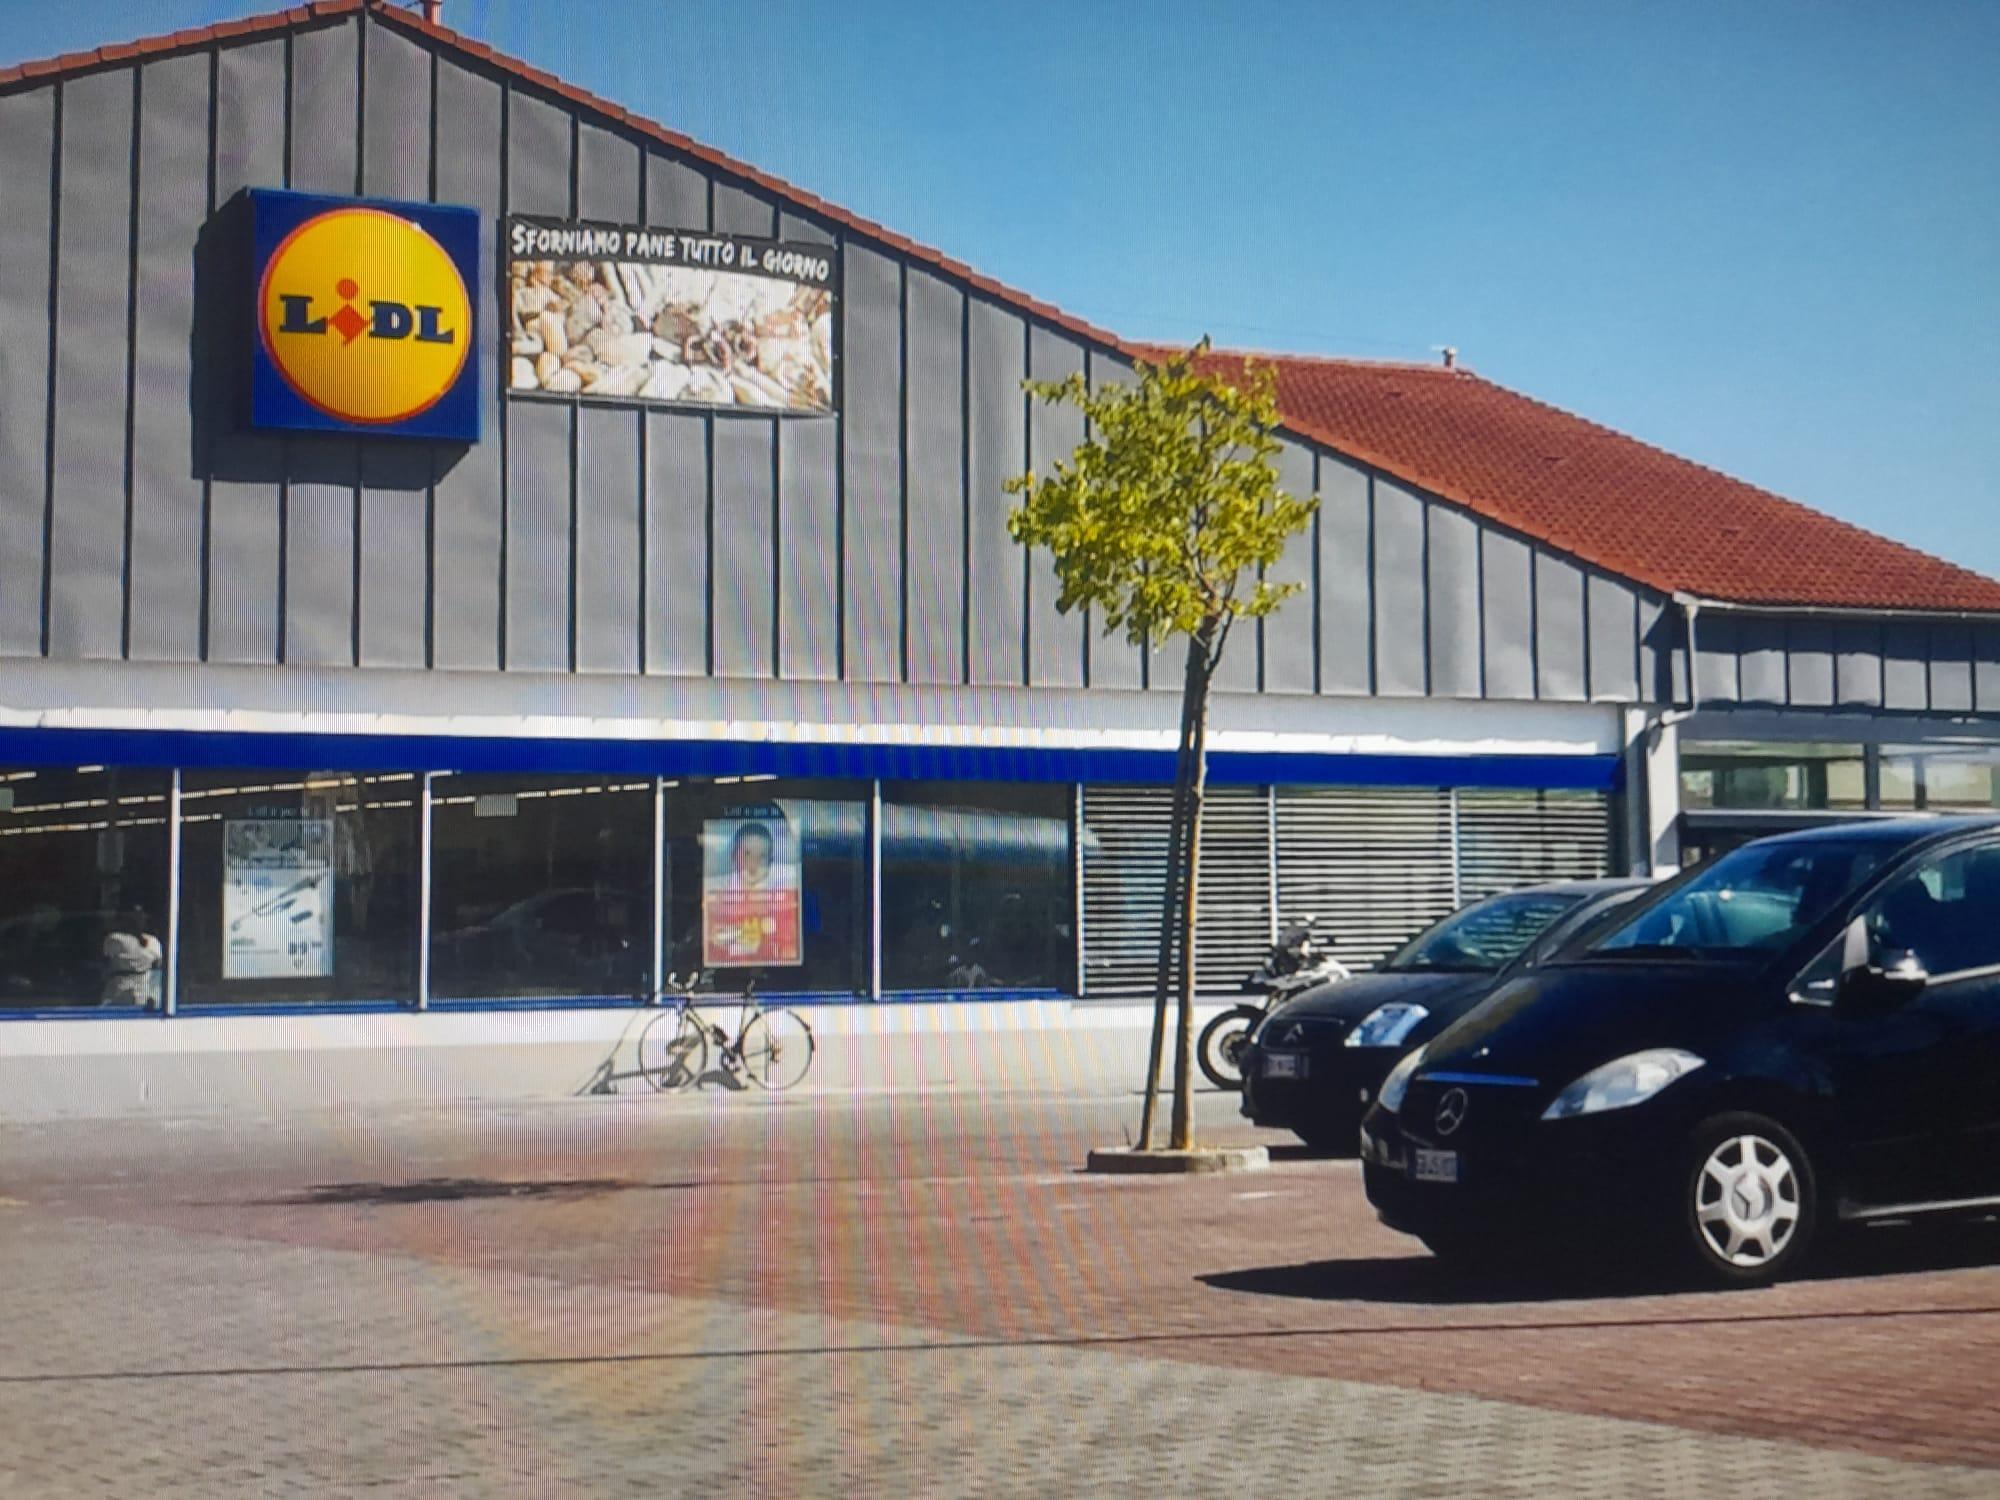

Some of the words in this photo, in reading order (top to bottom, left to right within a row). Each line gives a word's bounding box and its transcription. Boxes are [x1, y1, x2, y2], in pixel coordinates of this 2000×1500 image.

[511, 223, 621, 256] SFORNIAMO
[625, 231, 676, 258] PANE
[679, 236, 735, 265] TUTTO
[740, 243, 758, 267] IL
[762, 247, 830, 282] GIORNO
